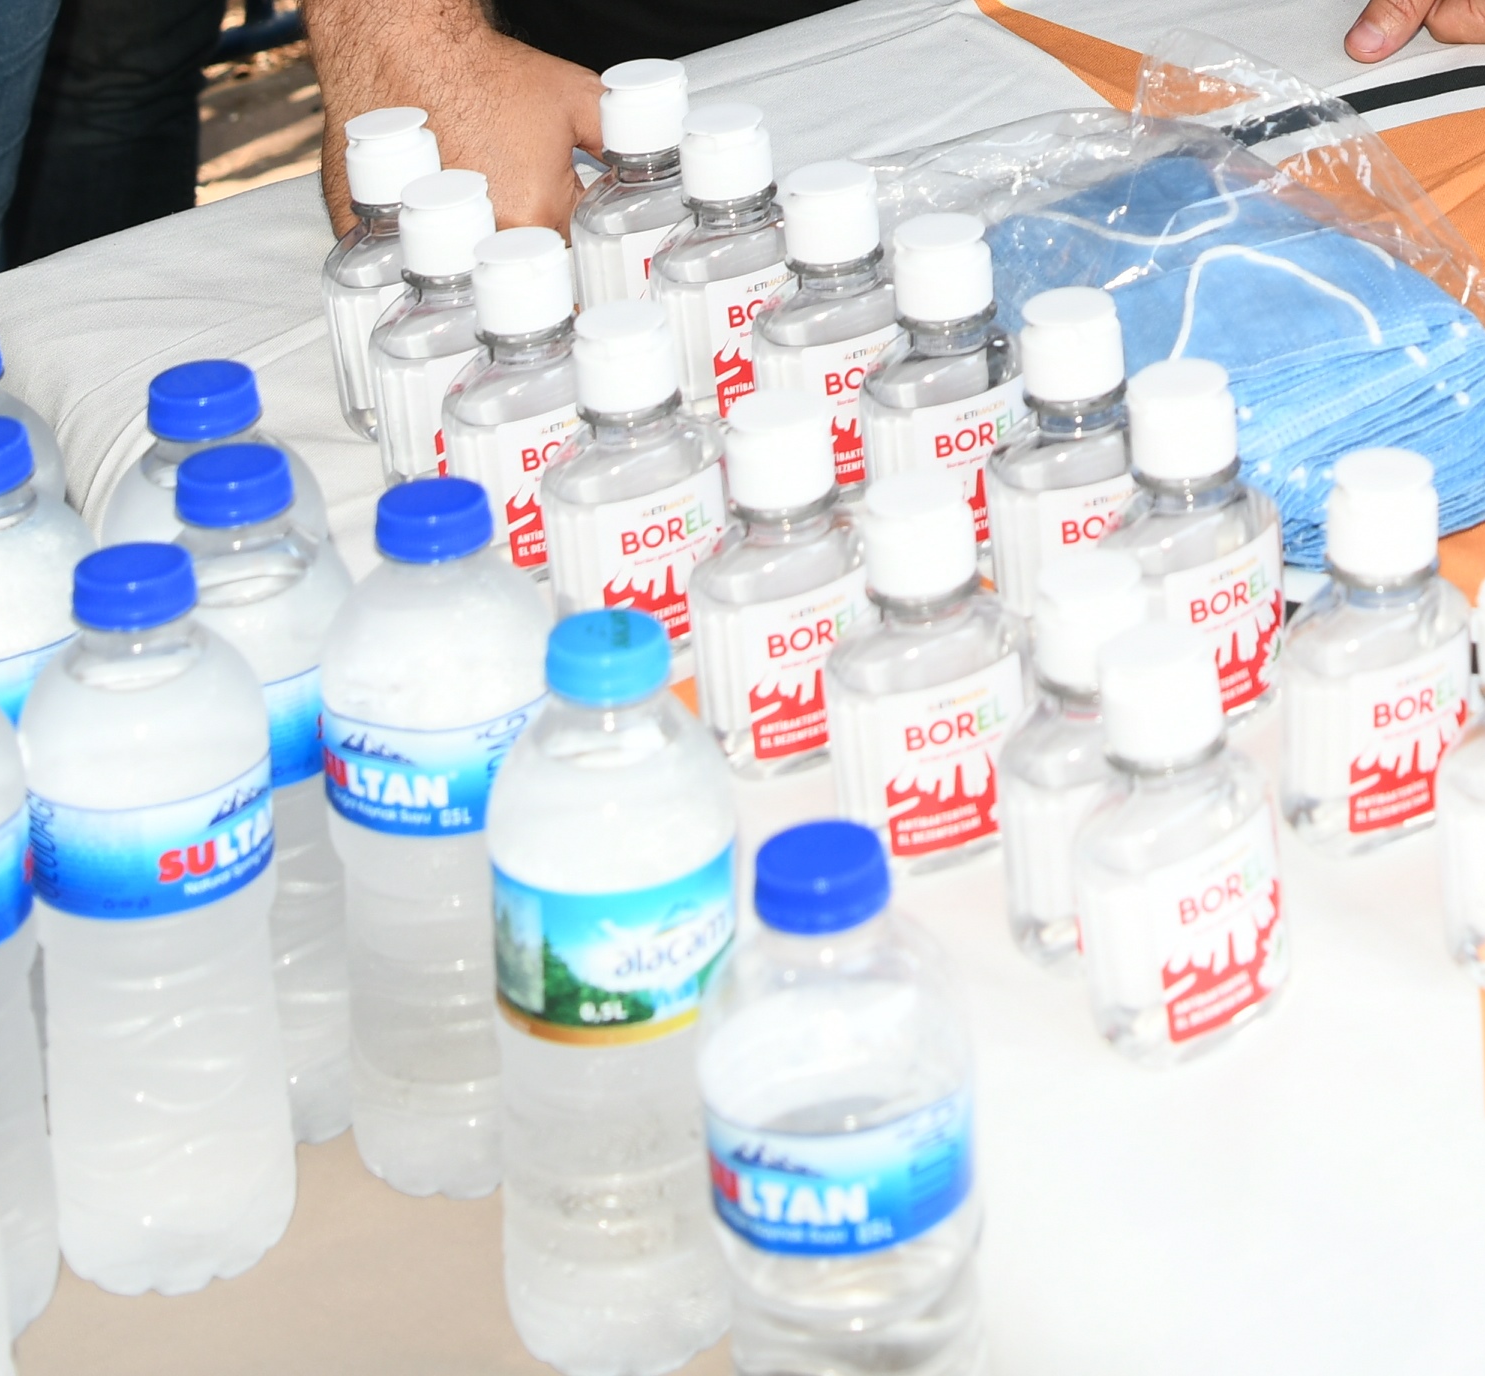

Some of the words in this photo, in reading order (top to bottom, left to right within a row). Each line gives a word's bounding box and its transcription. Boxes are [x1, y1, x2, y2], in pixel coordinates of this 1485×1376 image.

[621, 501, 712, 555] BOREL
[1191, 566, 1271, 624] BOREL
[905, 694, 1007, 751] BOREL
[1374, 680, 1456, 728] BOREL
[1178, 854, 1267, 926] BOREL
